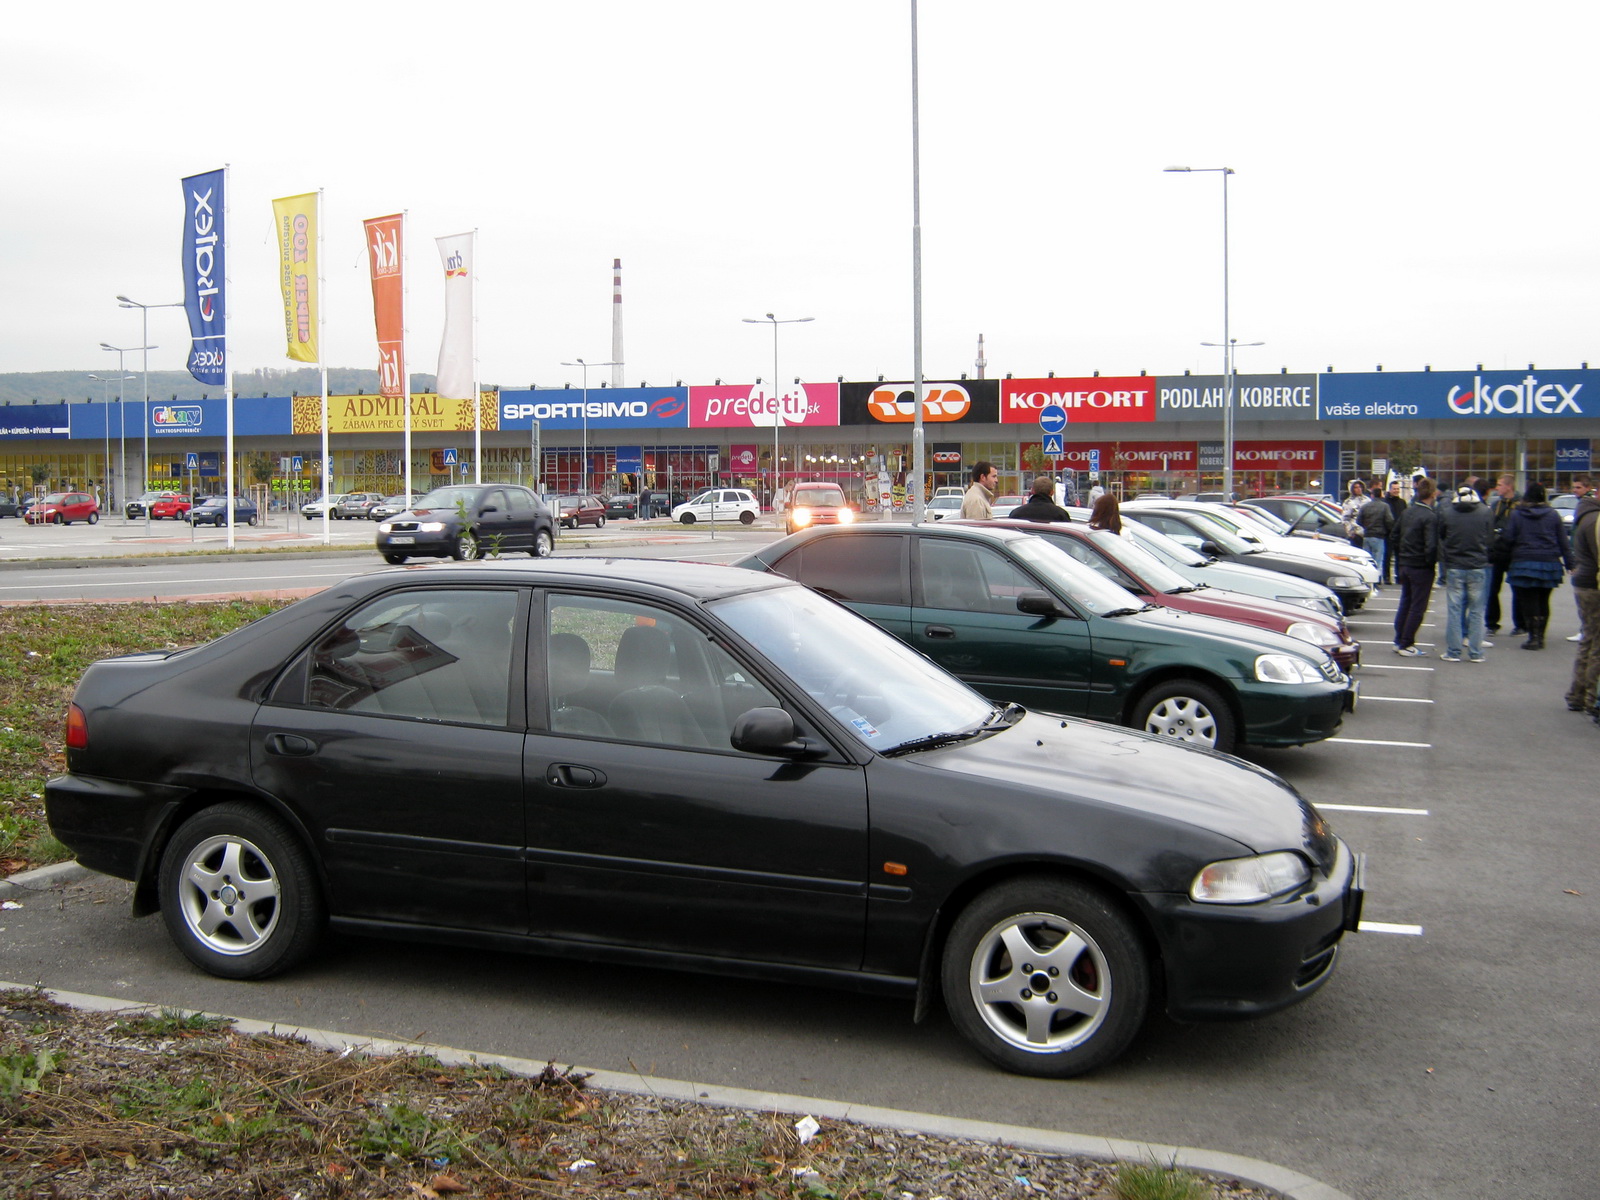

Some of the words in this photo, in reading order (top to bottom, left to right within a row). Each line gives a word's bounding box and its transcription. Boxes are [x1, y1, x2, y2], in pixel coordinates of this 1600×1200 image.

[872, 388, 965, 416] ROKO
[1009, 390, 1148, 409] KOMFORT
[1240, 386, 1311, 408] KOBERCE
[1448, 375, 1583, 415] elsatex
[343, 397, 444, 416] ADMIRAL
[503, 401, 648, 419] SPORTISIMO
[1325, 402, 1360, 416] vaše
[1365, 402, 1418, 415] elektro
[343, 418, 375, 429] ZÁBAVA
[378, 419, 394, 428] PRE
[397, 417, 419, 428] CÝ
[422, 419, 444, 428] SVET
[1114, 451, 1193, 461] KOMFORT
[1200, 457, 1224, 465] KOBERC
[1235, 450, 1317, 461] KOMFORT
